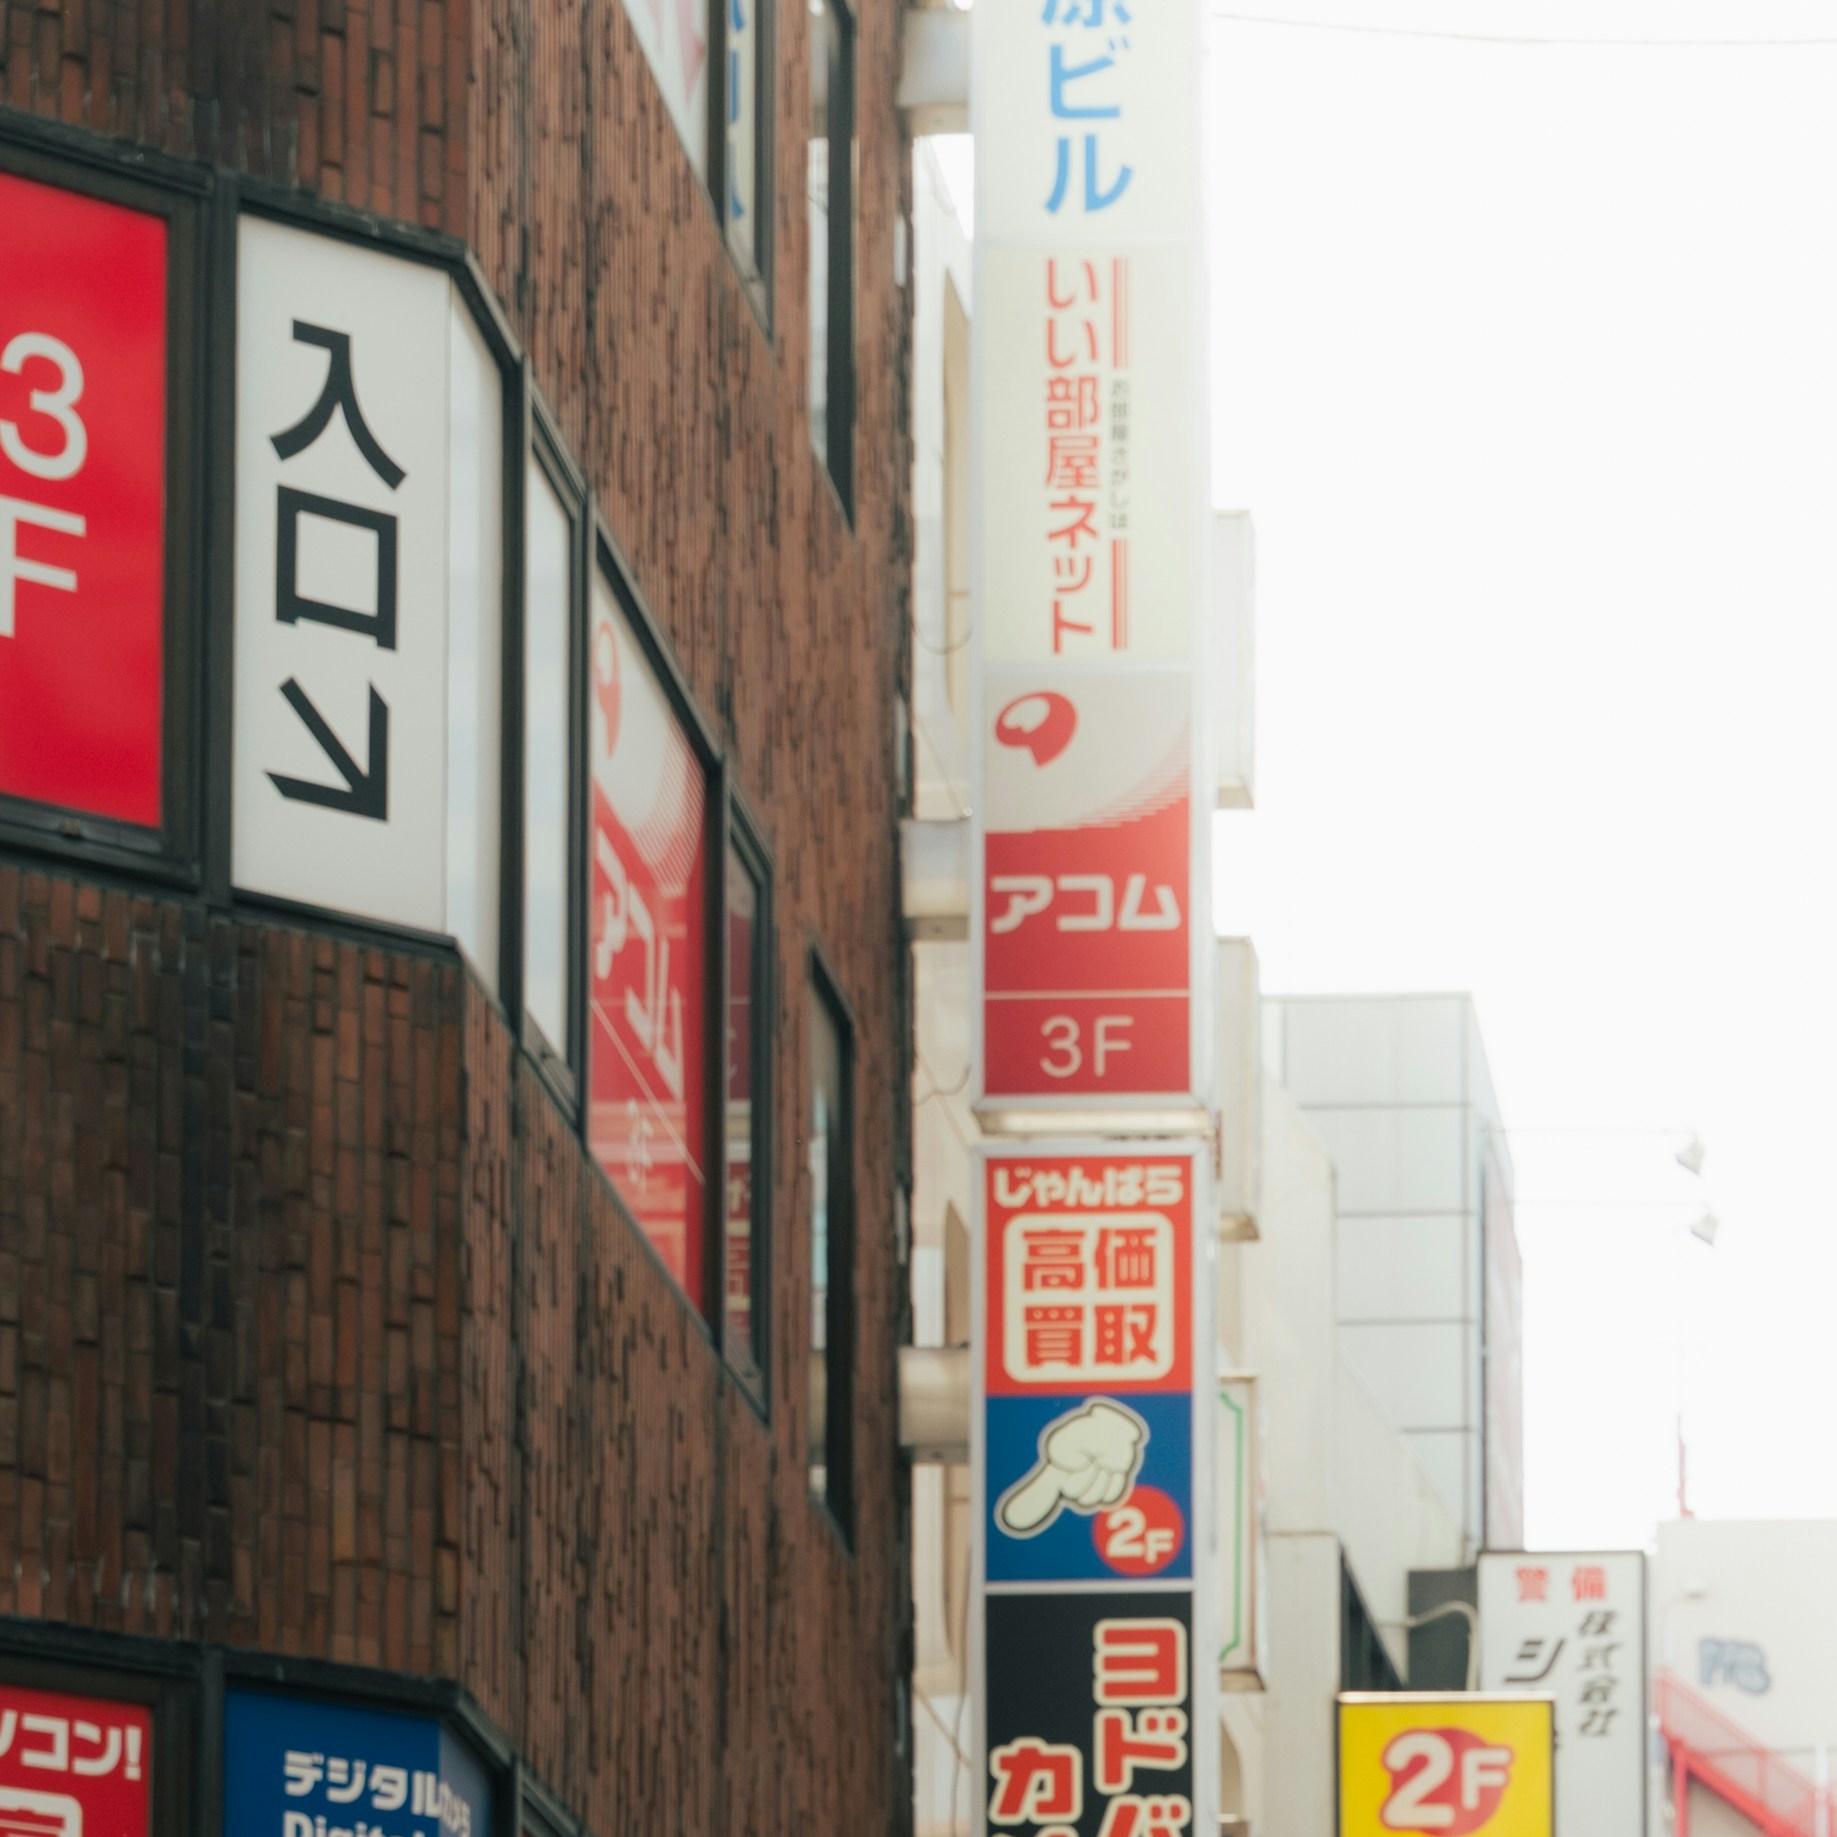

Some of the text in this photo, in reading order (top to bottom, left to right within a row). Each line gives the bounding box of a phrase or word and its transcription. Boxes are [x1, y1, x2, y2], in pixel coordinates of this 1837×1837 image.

[0, 331, 88, 640] 3F
[269, 318, 408, 653] 入口
[1043, 256, 1102, 656] いい部屋ネット
[990, 873, 1182, 934] アコム
[1040, 1014, 1135, 1078] 3F
[993, 1164, 1184, 1209] じゃんぱら
[1021, 1226, 1159, 1293] 高価
[1105, 1508, 1175, 1565] 2F
[1380, 1730, 1514, 1831] 2F
